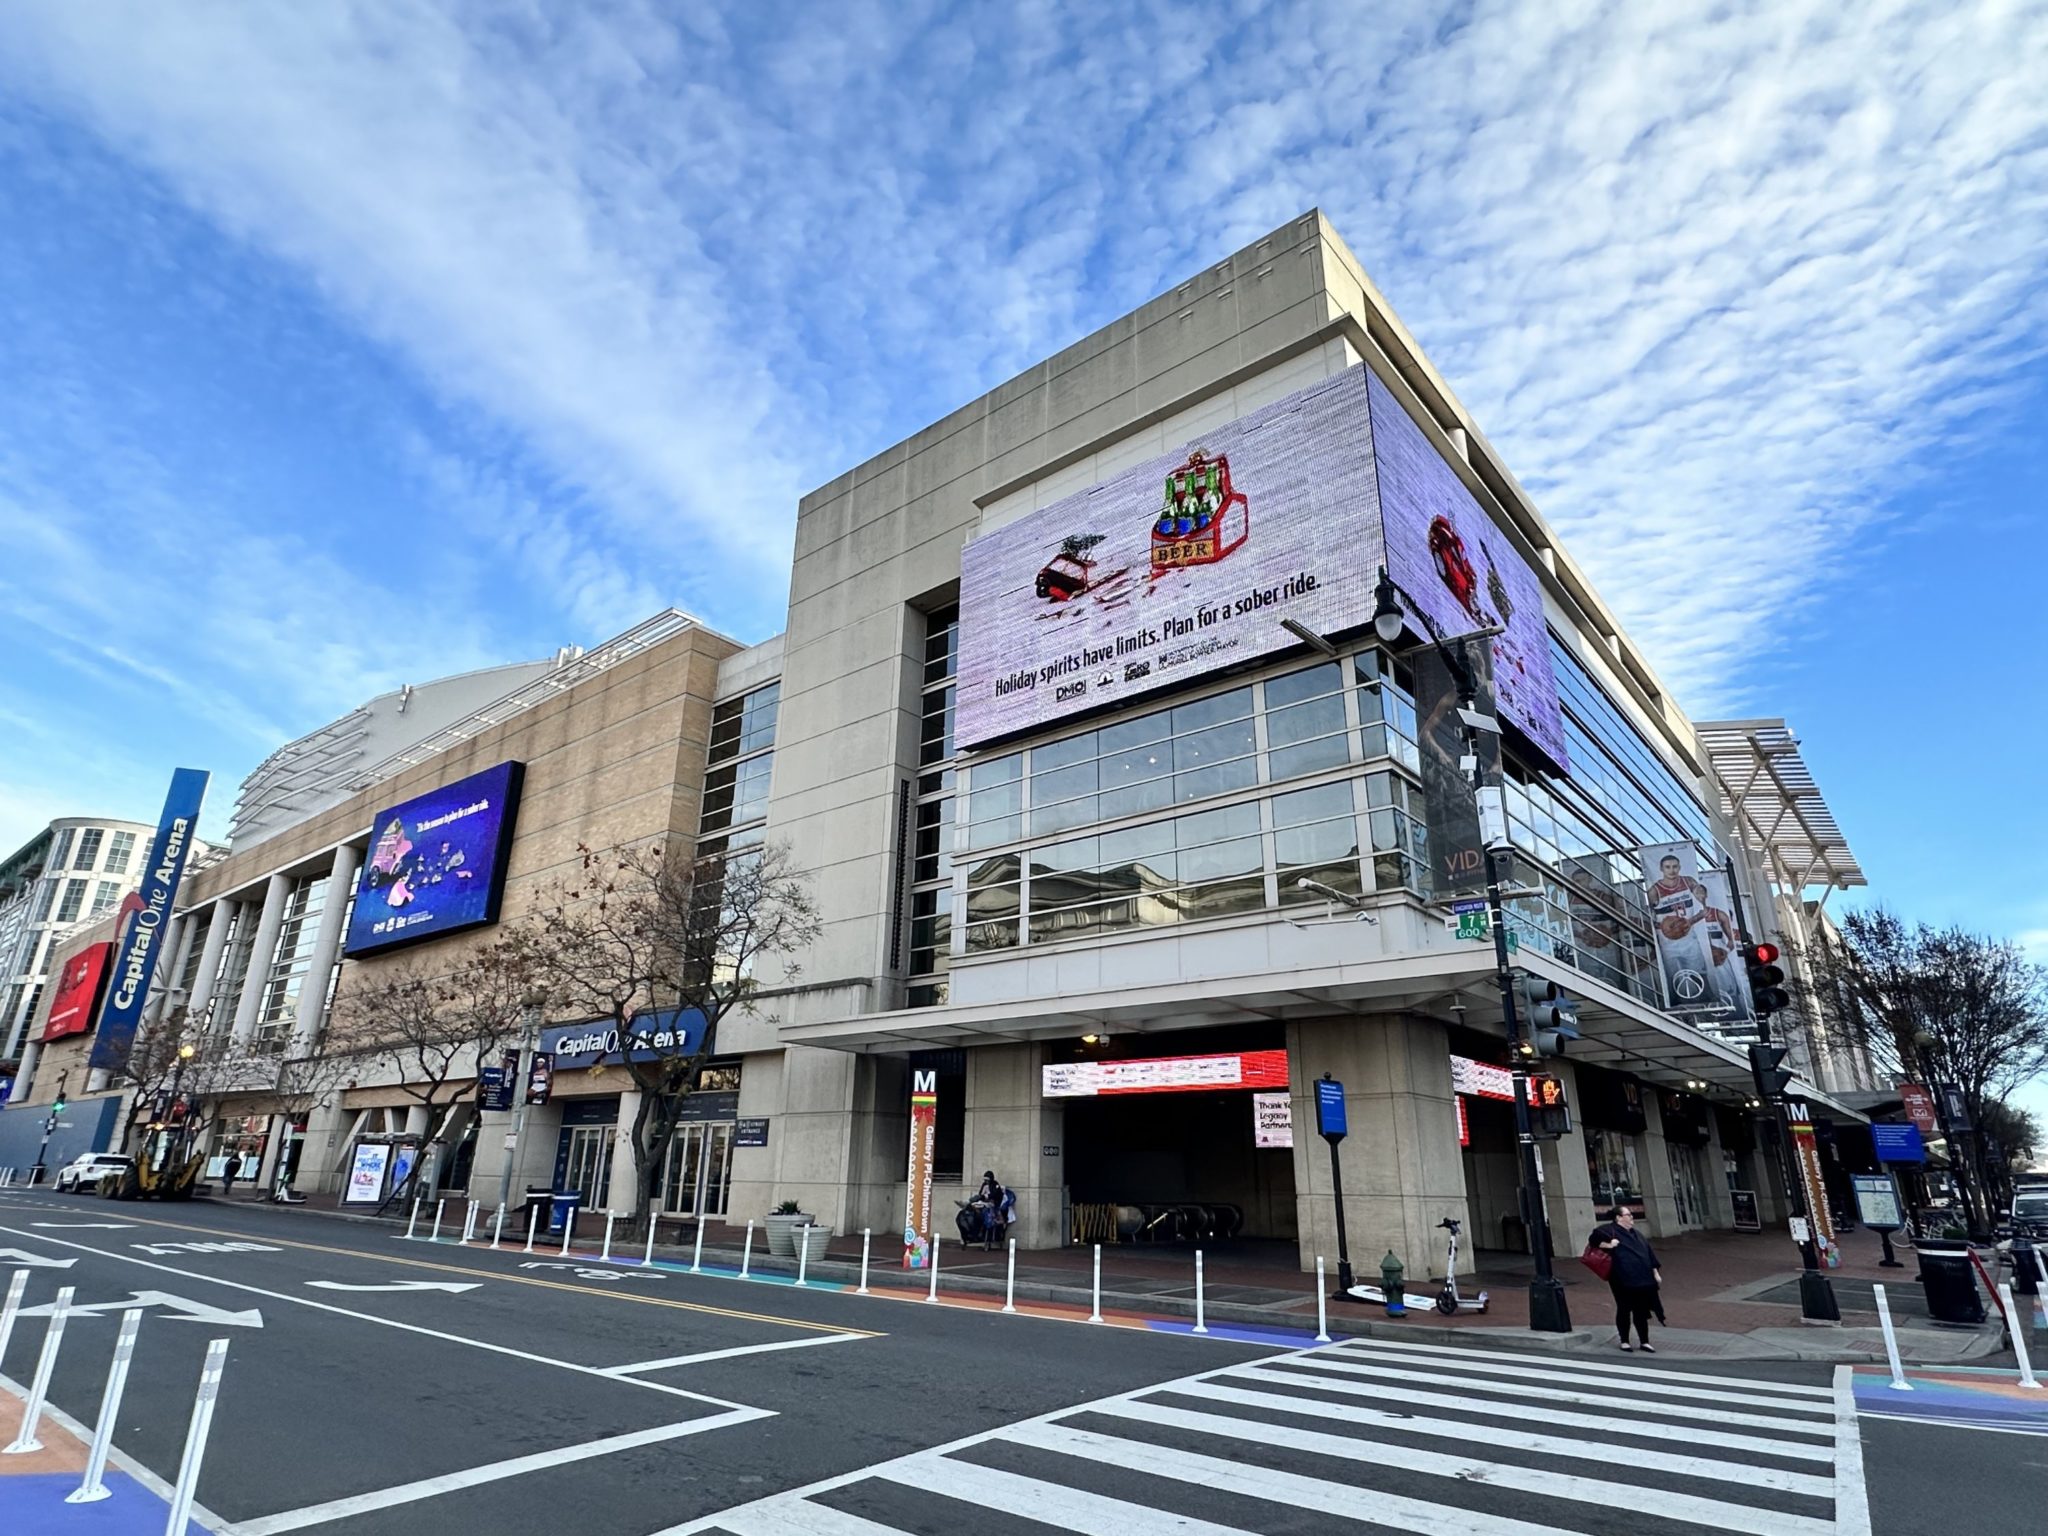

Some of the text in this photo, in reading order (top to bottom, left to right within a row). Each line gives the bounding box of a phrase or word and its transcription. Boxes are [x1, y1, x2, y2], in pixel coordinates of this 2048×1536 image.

[1158, 543, 1208, 561] BEER
[995, 671, 1037, 697] Holiday
[1040, 655, 1080, 684] spirits
[1083, 643, 1113, 667] have
[1116, 629, 1160, 656] limits.
[1164, 617, 1194, 640] Plan
[1197, 607, 1218, 628] for
[1222, 604, 1231, 620] a
[1235, 587, 1279, 616] sober
[1283, 572, 1321, 599] ride.
[155, 818, 188, 886] Arena
[1444, 849, 1485, 873] VID
[1467, 915, 1475, 927] 7
[1458, 928, 1480, 938] 600
[633, 1029, 687, 1051] Aena
[913, 1070, 936, 1092] M
[1259, 1101, 1282, 1110] Thank
[1790, 1103, 1810, 1121] M
[1259, 1112, 1288, 1122] Legacy
[1811, 1150, 1823, 1180] Gallery
[920, 1125, 935, 1233] Gallery Pl-Chinatown
